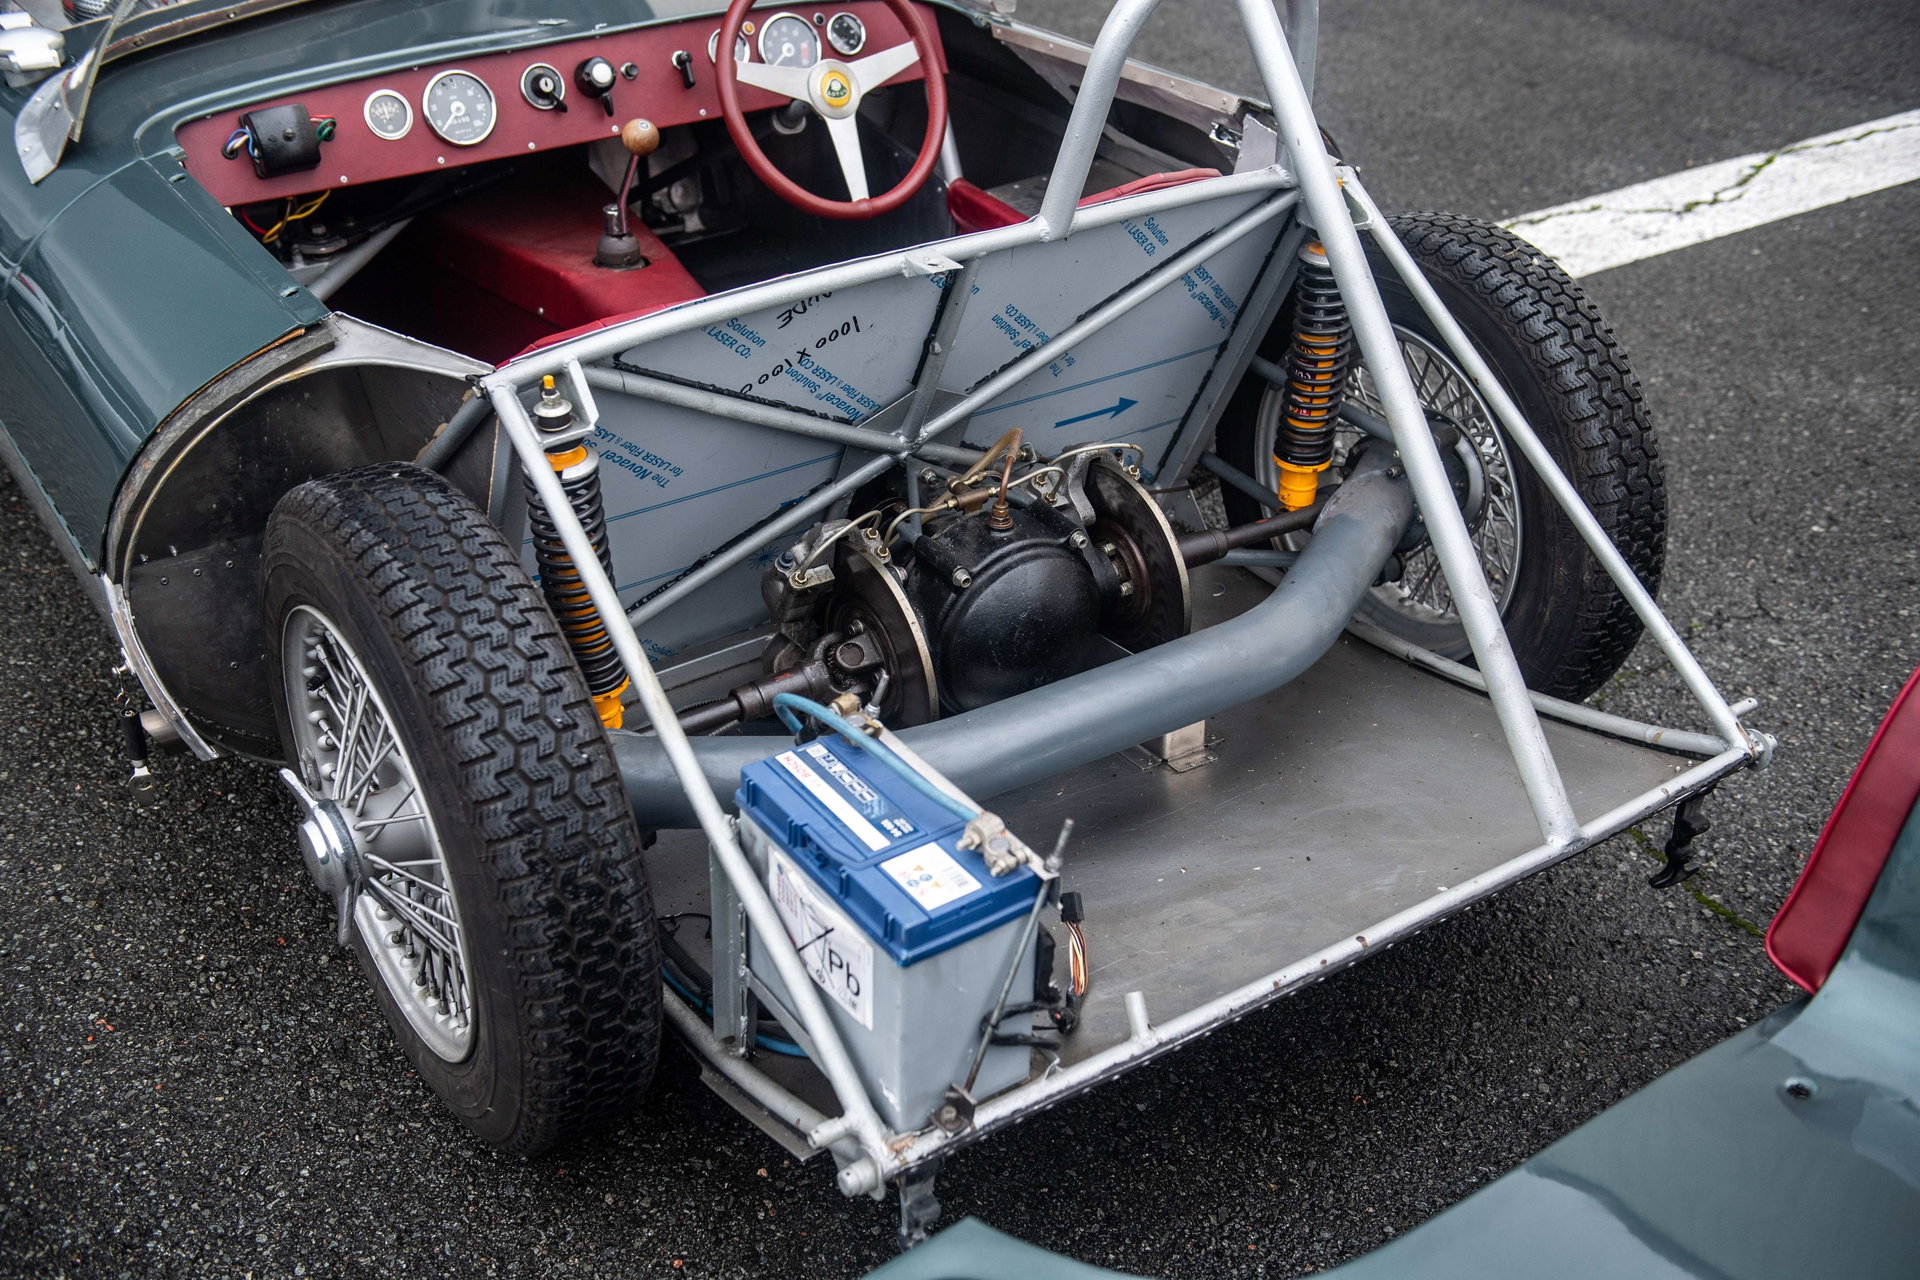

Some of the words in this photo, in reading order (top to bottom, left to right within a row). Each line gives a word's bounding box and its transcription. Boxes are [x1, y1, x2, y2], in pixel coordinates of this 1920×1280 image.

[1127, 225, 1147, 248] LASER
[1144, 216, 1168, 246] Solution
[1180, 273, 1198, 293] Solut
[1193, 264, 1213, 285] LASER
[726, 316, 767, 348] Solution
[815, 315, 861, 349] 1000
[991, 313, 1020, 341] Solution
[1013, 312, 1035, 333] LASER
[706, 326, 738, 350] LASER
[740, 358, 793, 394] 1000
[784, 365, 821, 395] Solution
[811, 366, 838, 386] LASER
[1050, 362, 1063, 377] The
[839, 383, 861, 400] Fiber
[855, 394, 882, 412] LASER
[620, 440, 645, 457] Fiber
[599, 449, 653, 480] Novacel
[642, 451, 672, 471] LASER
[669, 465, 684, 477] for
[651, 473, 670, 488] The
[828, 948, 861, 997] Pb
